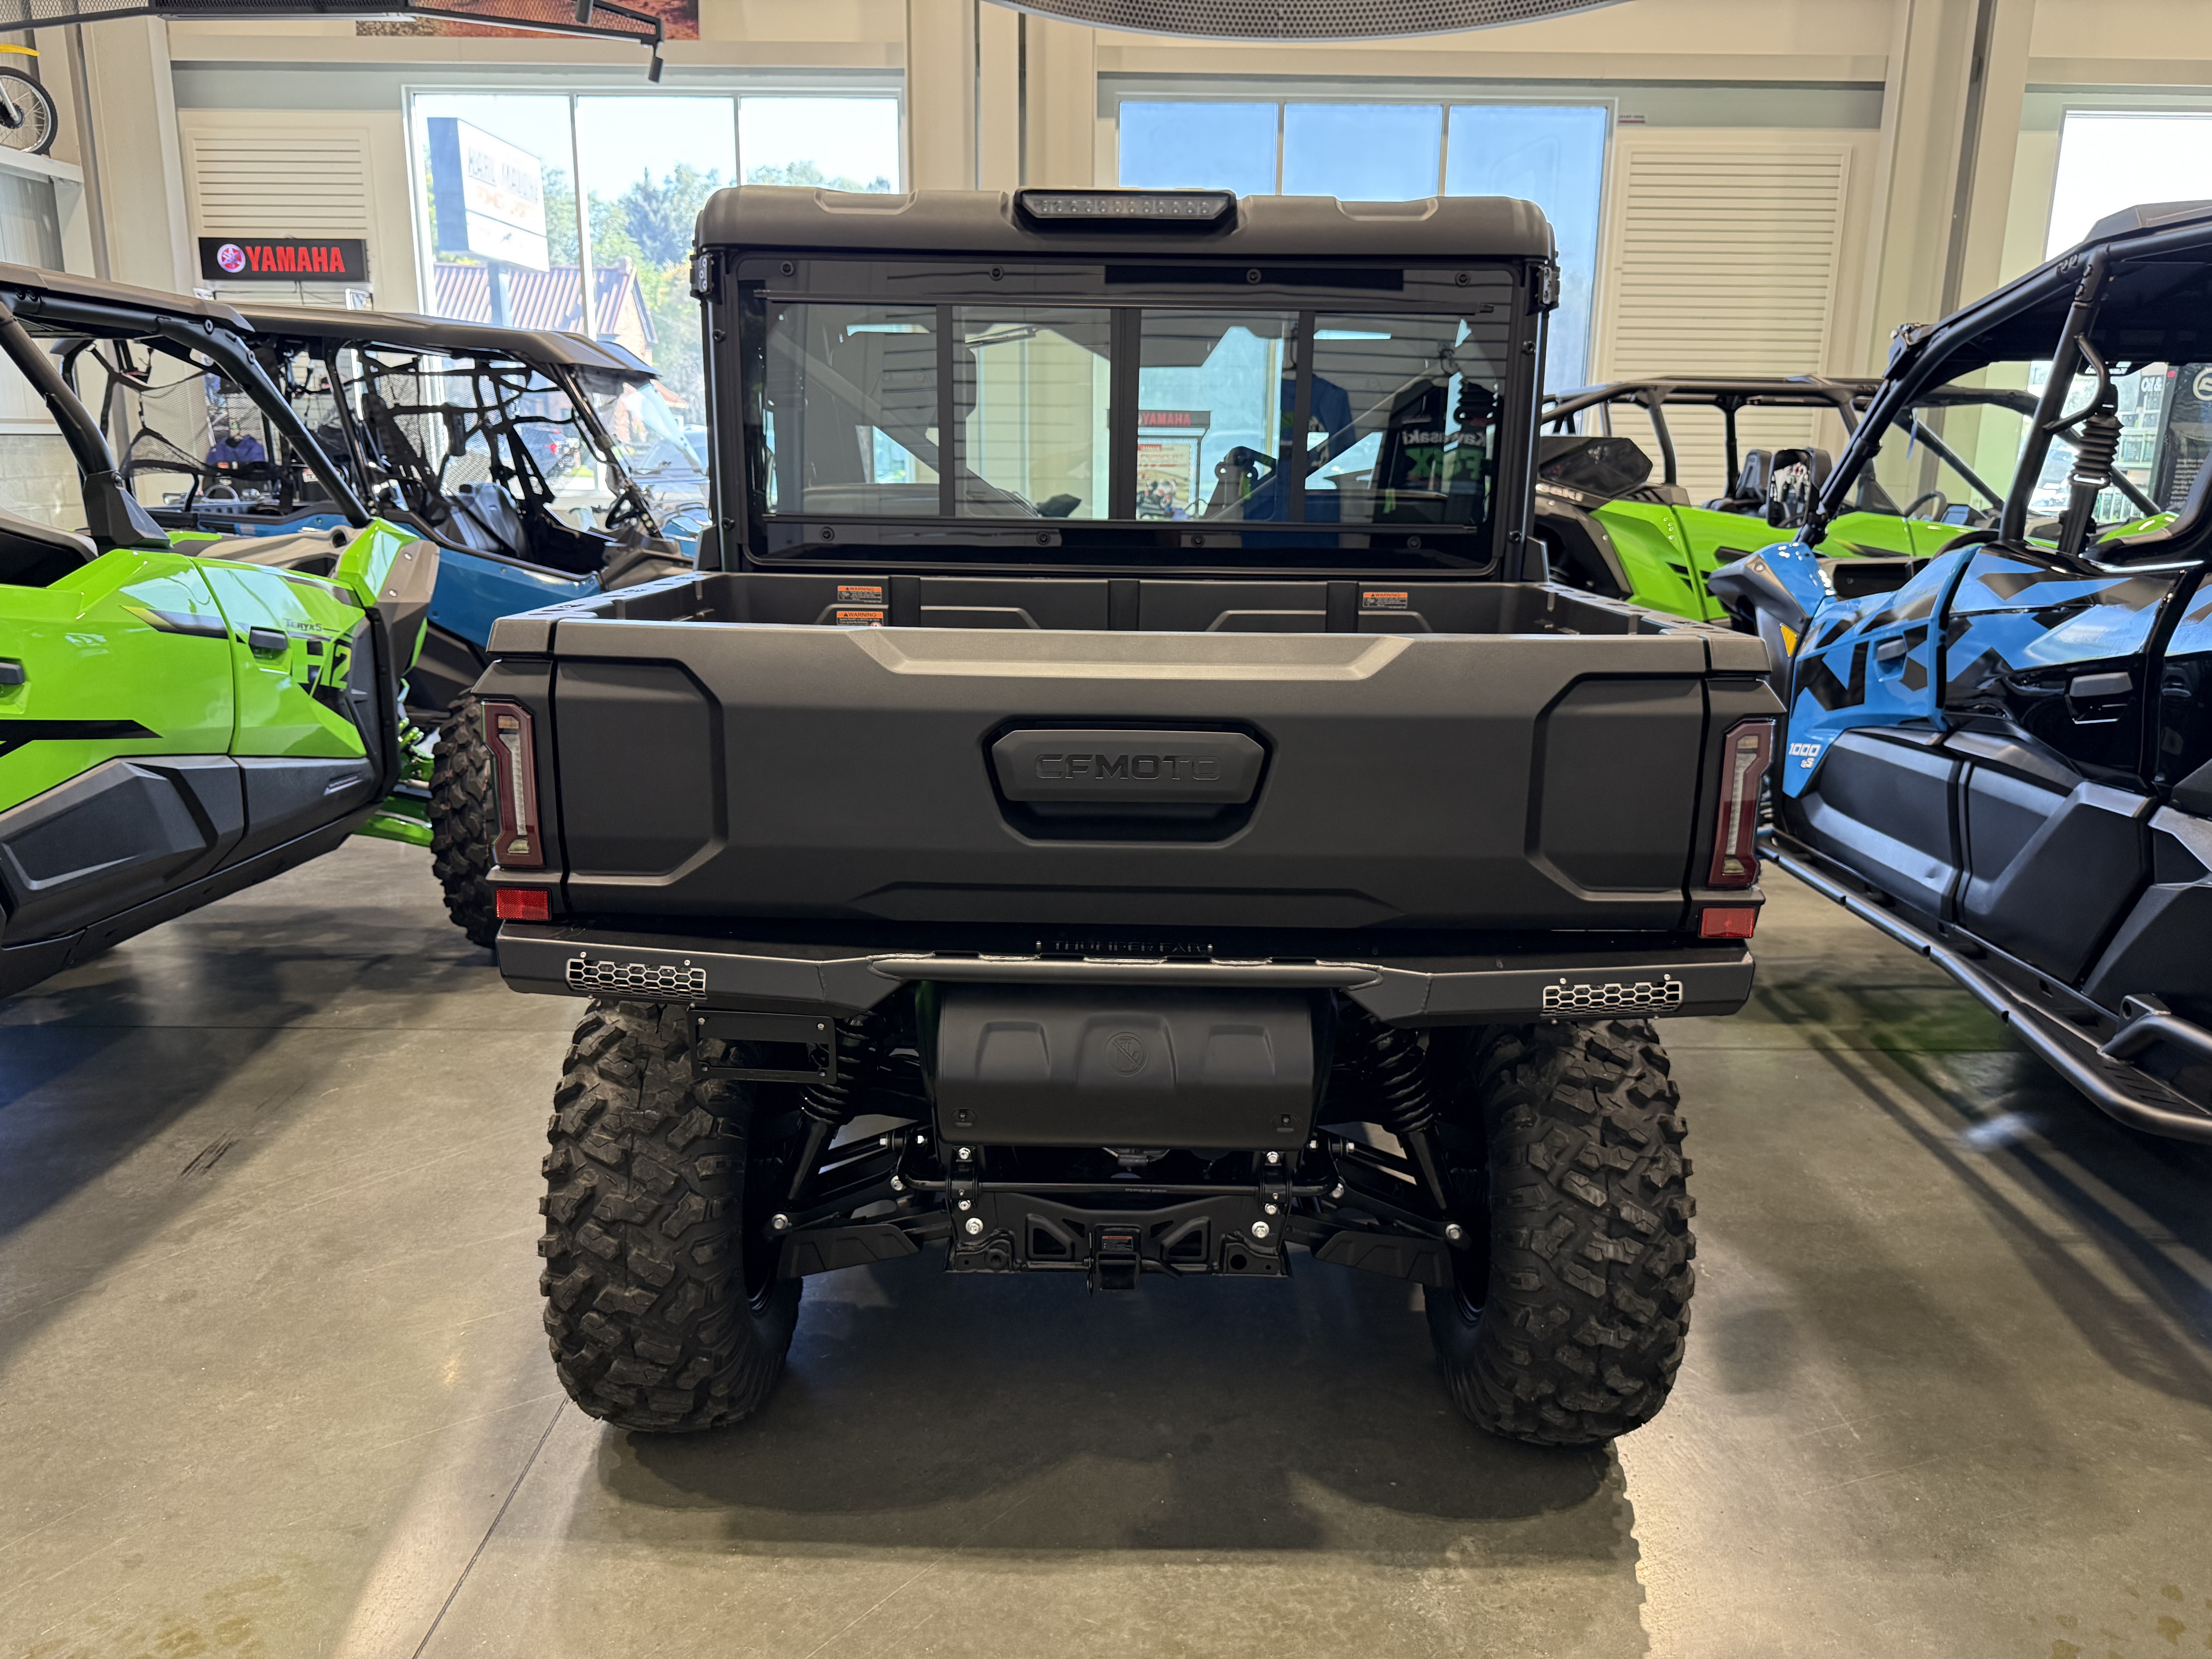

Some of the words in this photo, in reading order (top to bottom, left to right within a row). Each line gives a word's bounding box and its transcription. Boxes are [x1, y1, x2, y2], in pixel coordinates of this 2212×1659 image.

[246, 246, 345, 272] YAMAHA
[1143, 413, 1190, 425] YAMAHA
[290, 639, 352, 690] H2
[1788, 743, 1821, 757] 1000
[1036, 754, 1221, 780] CFMOTO
